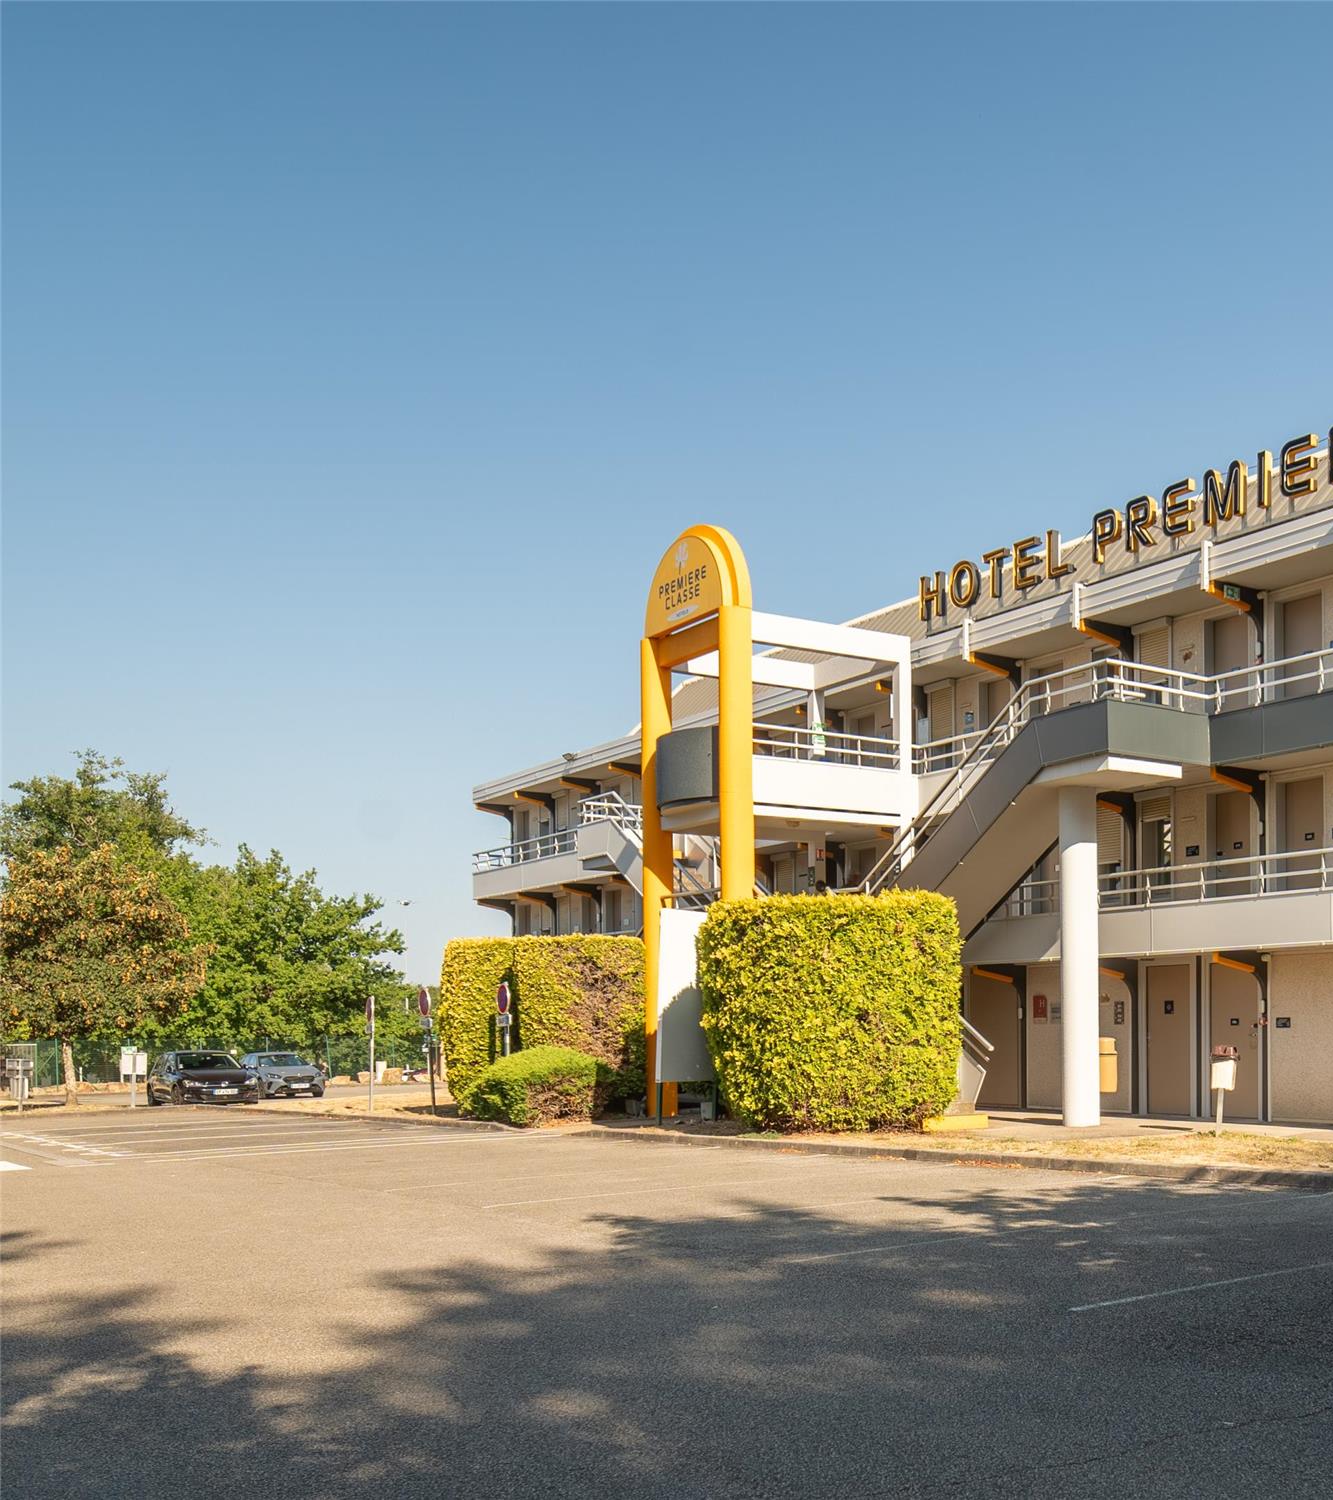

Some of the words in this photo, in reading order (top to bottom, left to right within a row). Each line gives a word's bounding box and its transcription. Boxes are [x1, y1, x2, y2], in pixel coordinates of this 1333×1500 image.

[659, 565, 706, 599] PREMIERE
[919, 529, 1076, 622] HOTEL
[665, 583, 700, 610] CLASSE
